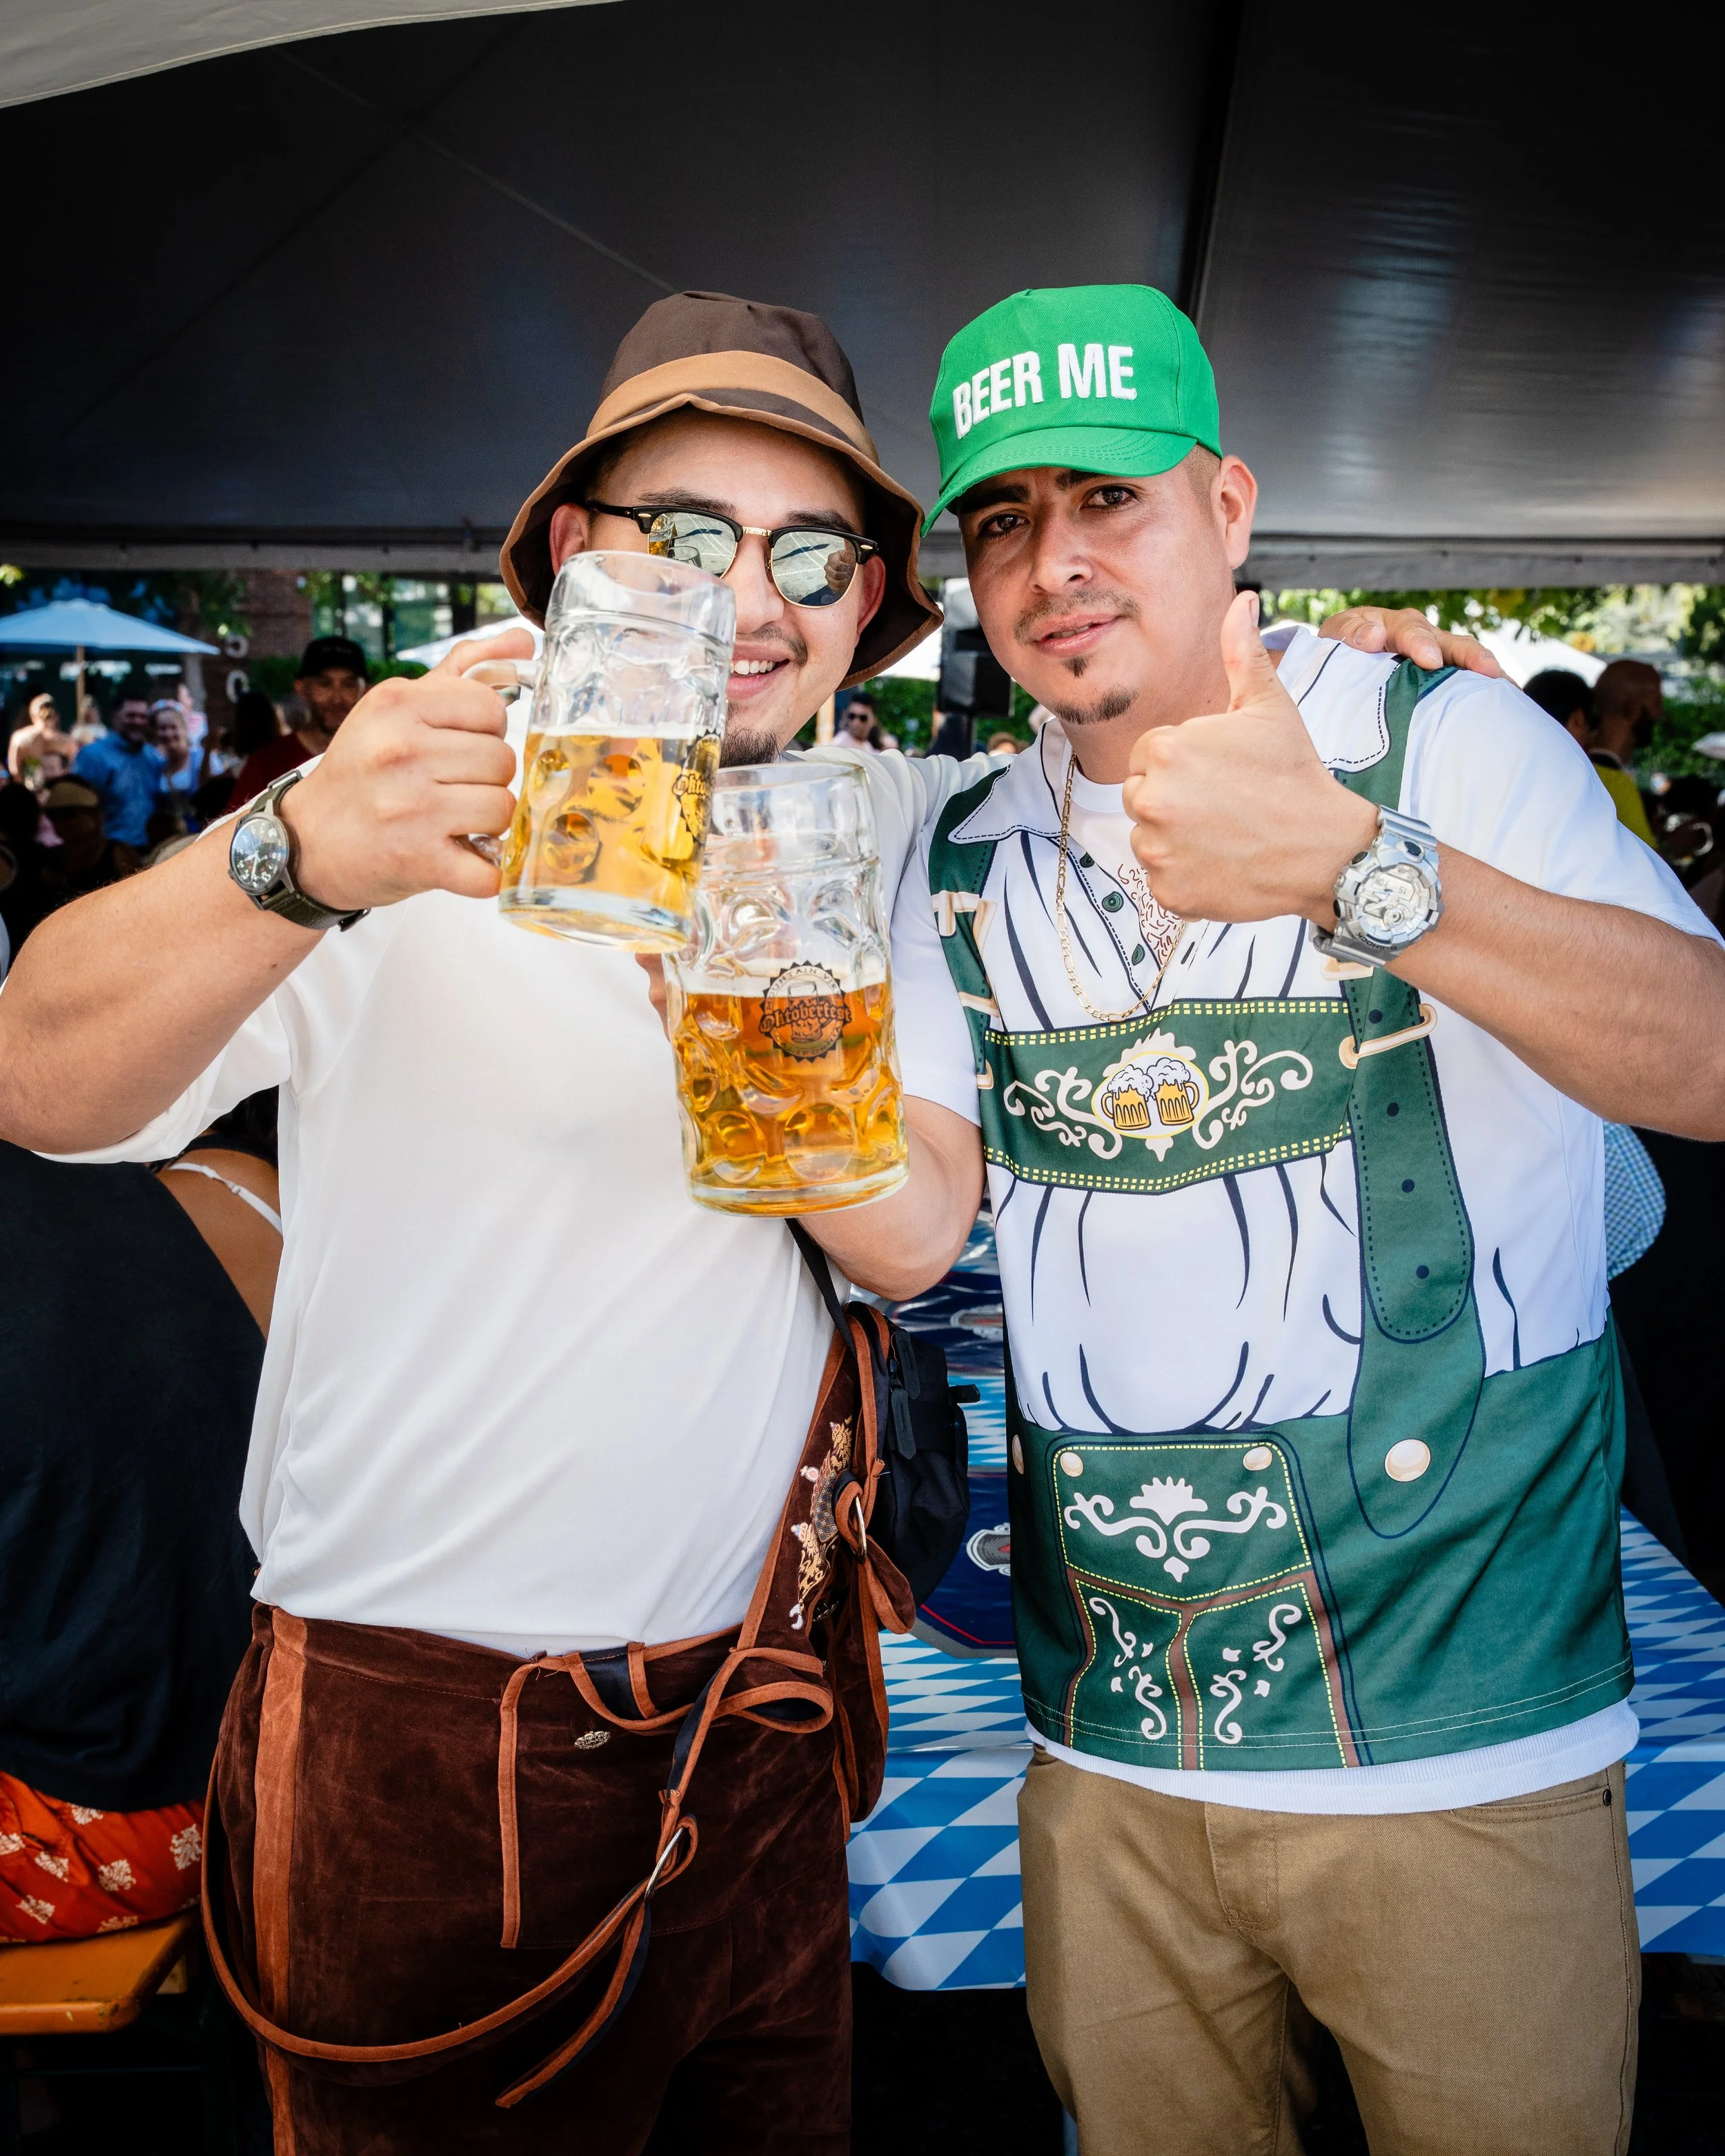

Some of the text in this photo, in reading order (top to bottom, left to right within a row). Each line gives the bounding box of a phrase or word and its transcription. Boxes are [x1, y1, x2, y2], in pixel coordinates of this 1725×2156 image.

[952, 343, 1137, 439] BEER ME
[1356, 932, 1397, 951] G-SHOCK
[767, 967, 842, 1010] MOUNTAIN VIEW
[760, 1002, 852, 1034] Oktoberfest
